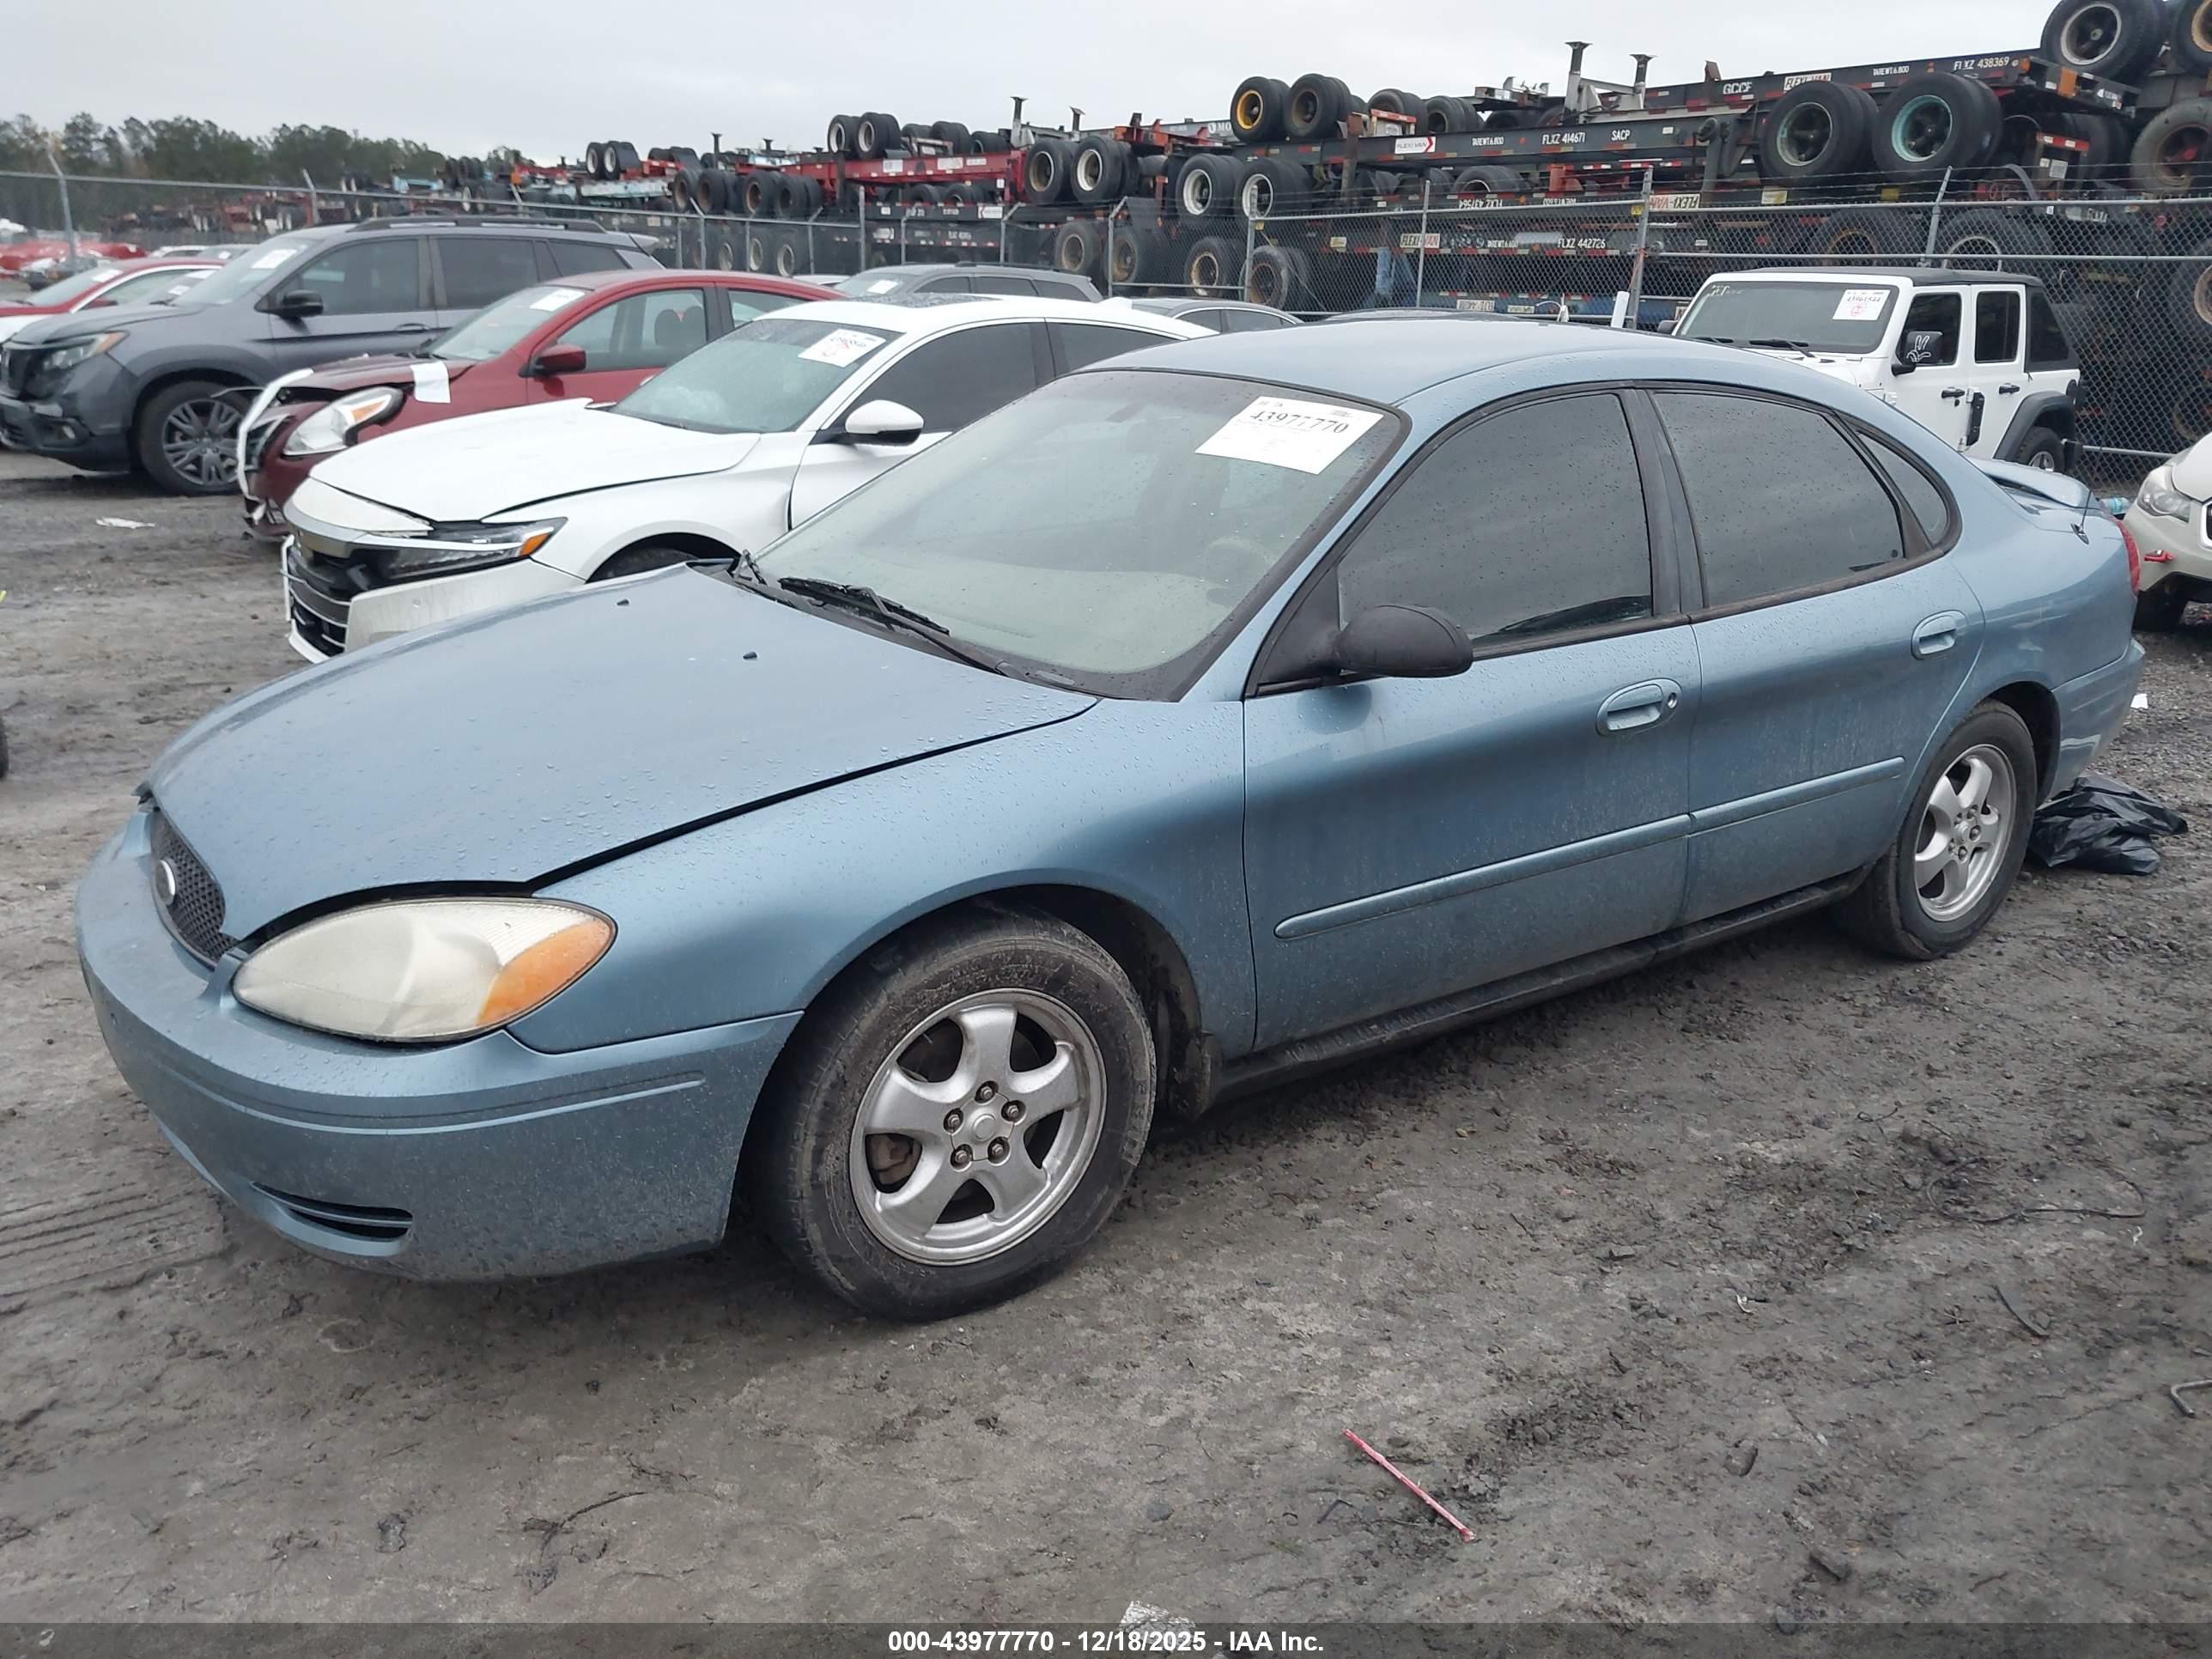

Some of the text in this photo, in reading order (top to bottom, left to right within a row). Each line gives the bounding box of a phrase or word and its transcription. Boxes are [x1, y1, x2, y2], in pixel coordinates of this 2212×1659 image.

[1977, 57, 2010, 69] 438369
[1542, 131, 1586, 145] FLXZ 414671
[1611, 130, 1631, 141] SACP
[1558, 238, 1607, 249] FLXZ 442726
